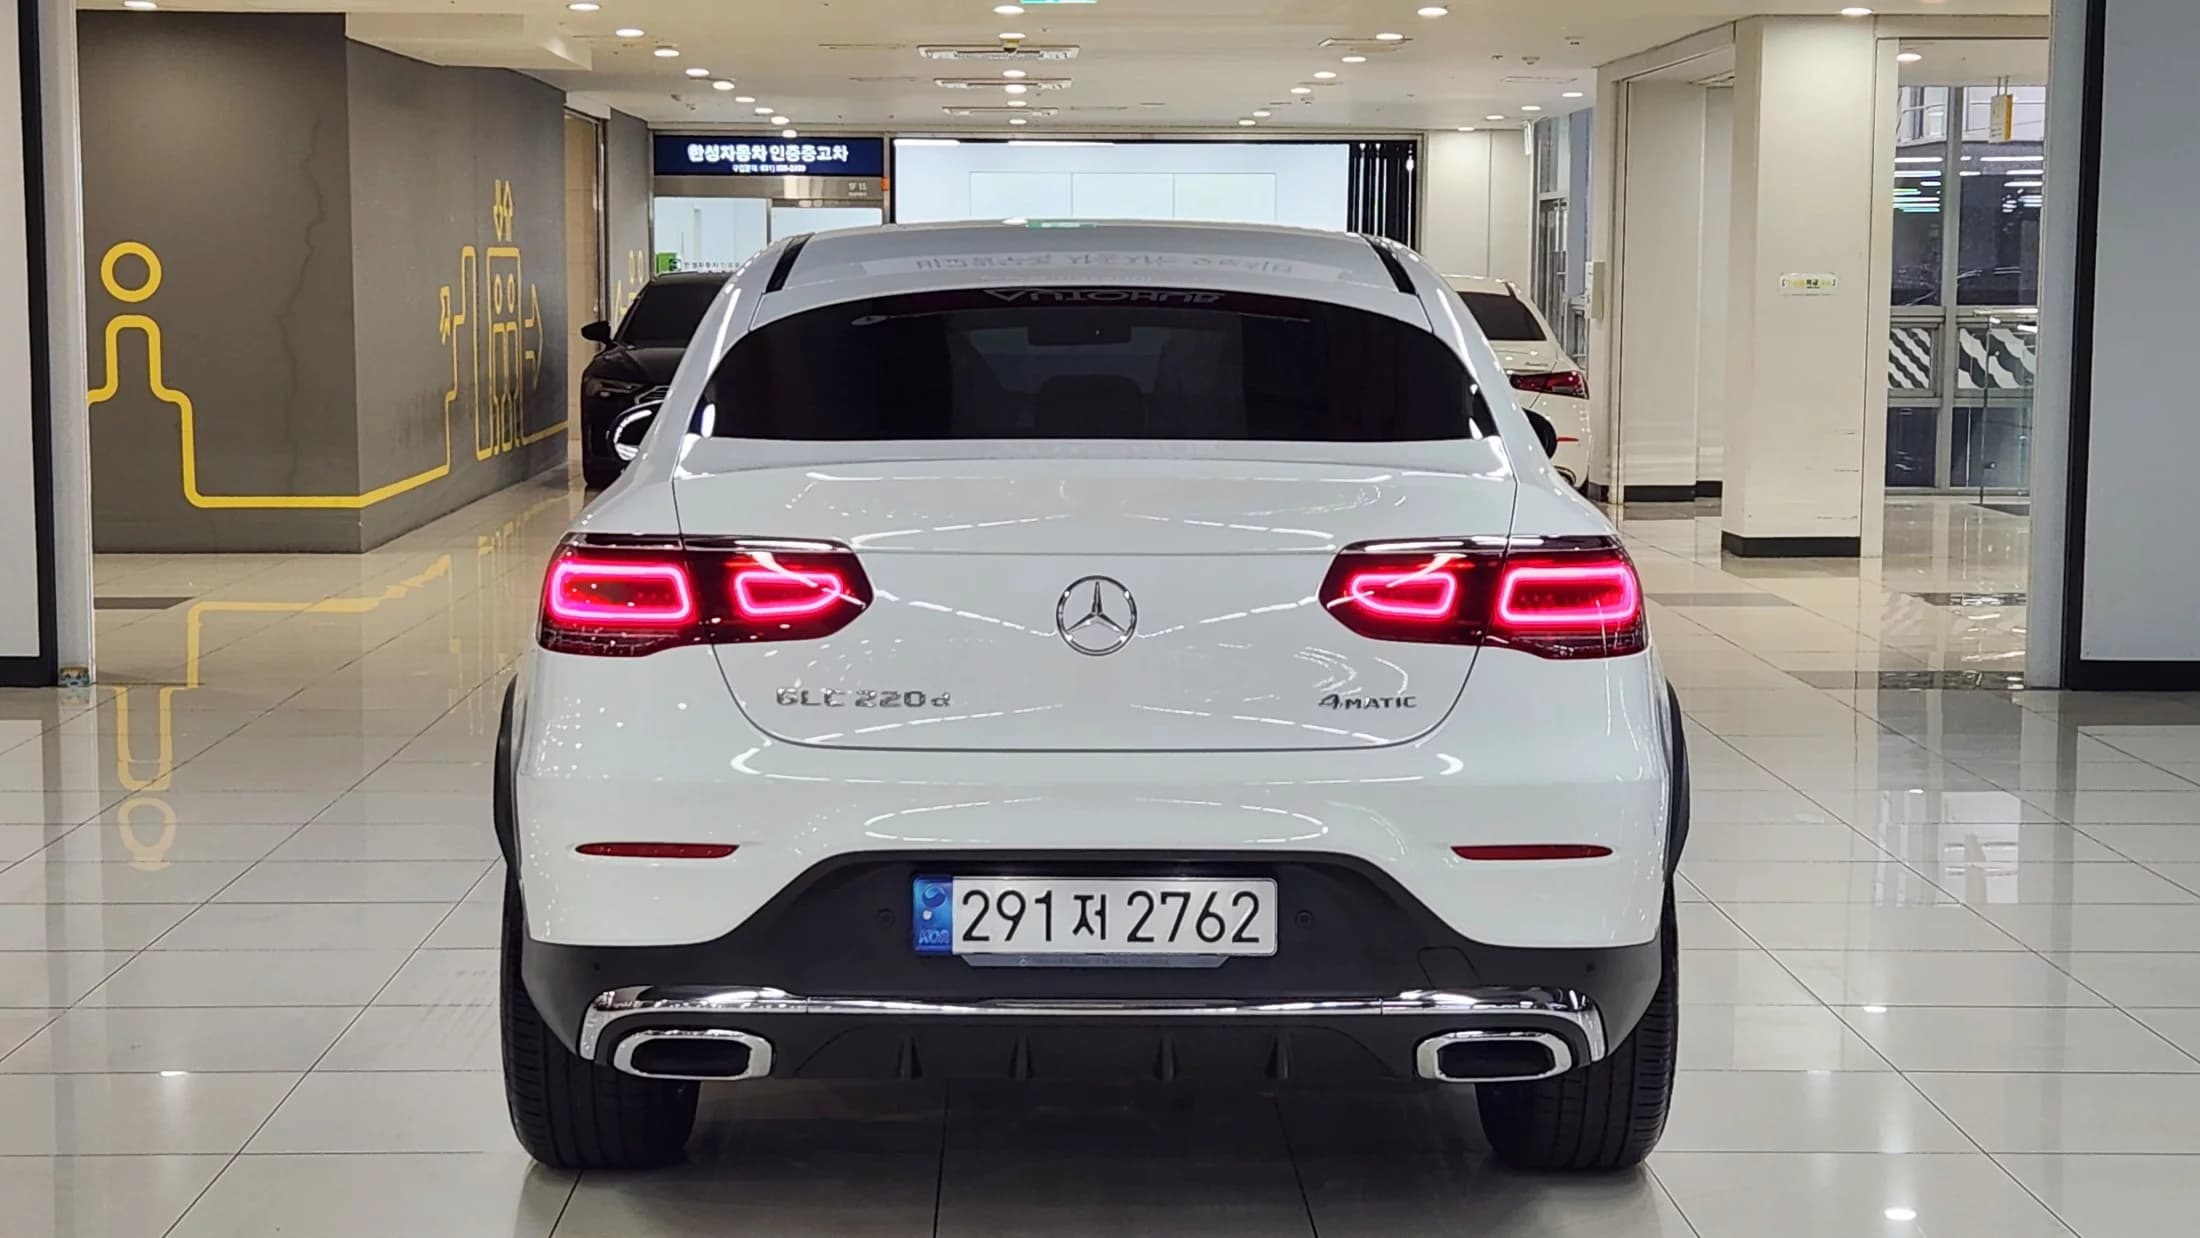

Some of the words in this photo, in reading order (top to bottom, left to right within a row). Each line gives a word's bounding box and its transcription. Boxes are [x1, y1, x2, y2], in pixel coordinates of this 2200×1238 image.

[687, 143, 768, 162] 한성자동차
[769, 144, 849, 162] 인증중고차
[776, 687, 845, 707] GLC
[1318, 693, 1417, 710] 4MATIC
